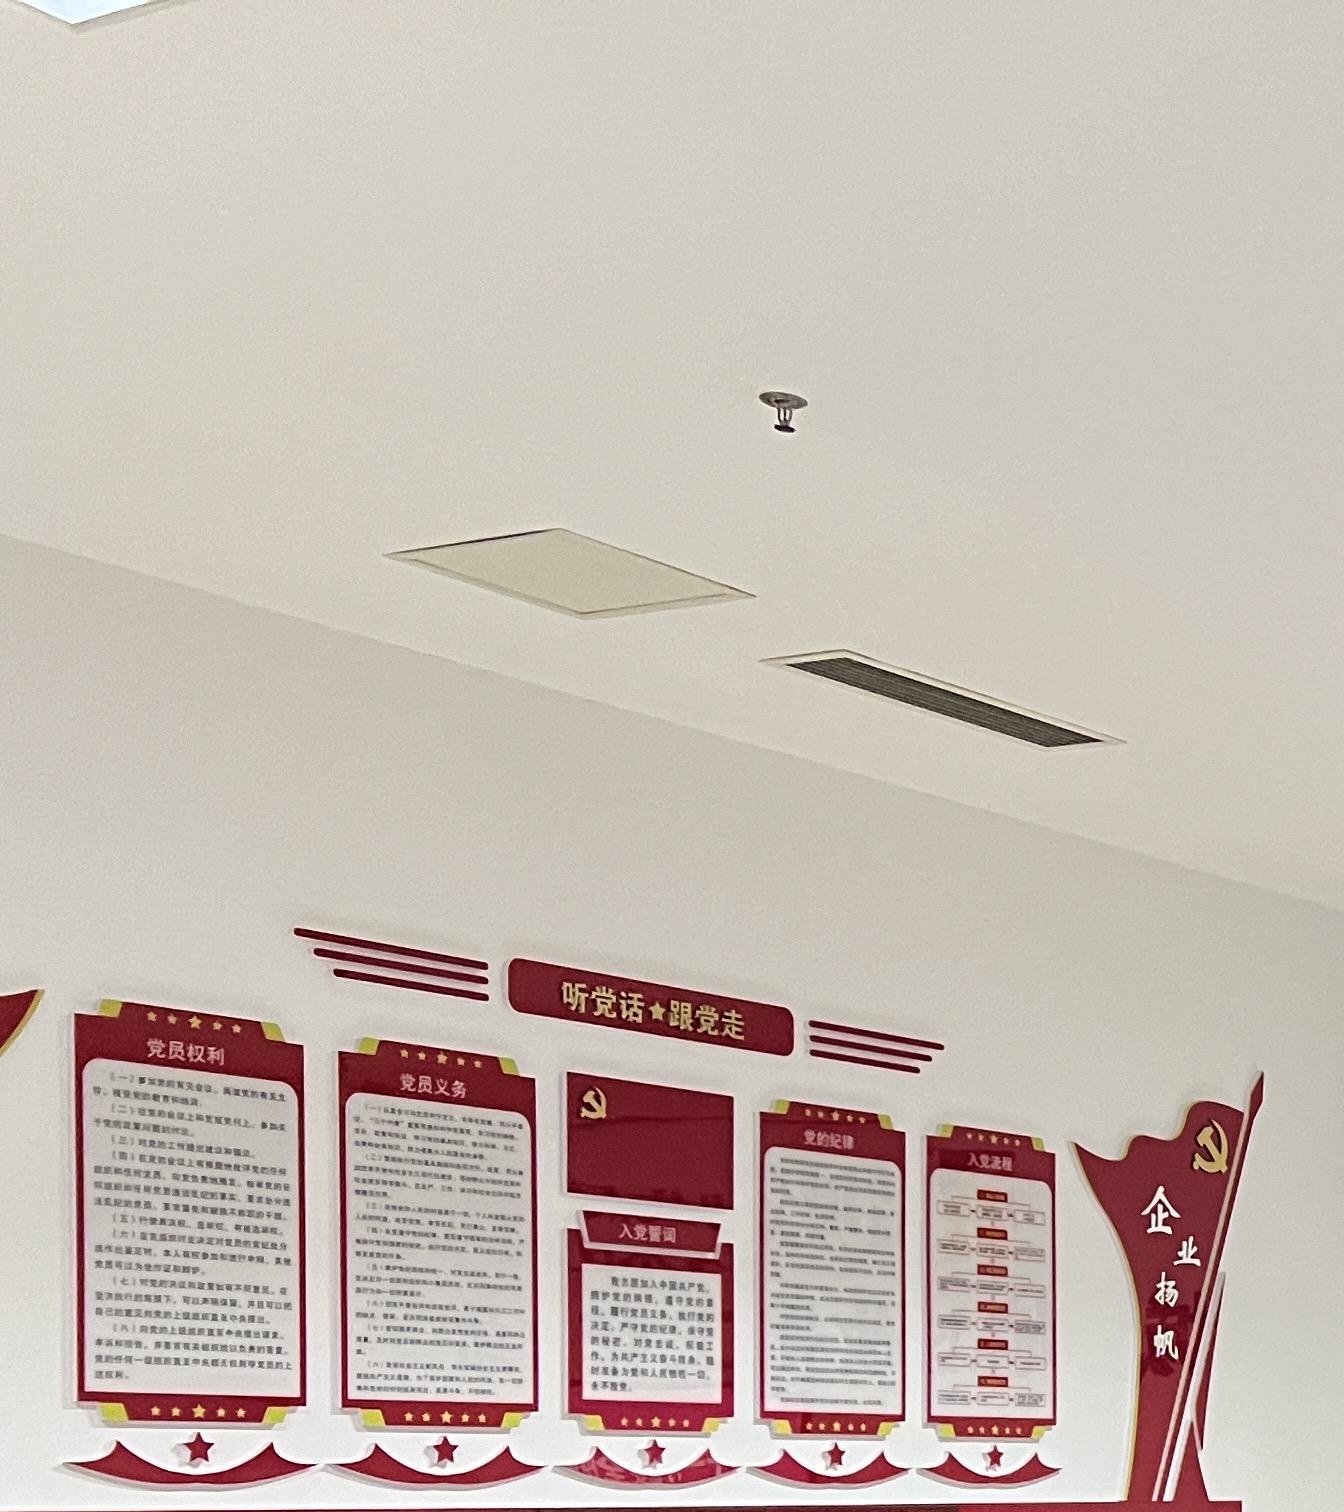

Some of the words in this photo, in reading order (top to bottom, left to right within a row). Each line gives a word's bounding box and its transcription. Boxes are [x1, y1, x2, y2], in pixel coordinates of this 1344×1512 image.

[561, 981, 645, 1024] 听党话
[669, 999, 745, 1041] 跟党走
[146, 1038, 225, 1065] 党员权利
[400, 1073, 467, 1098] 党员义务
[1141, 1186, 1201, 1360] 企业扬帆
